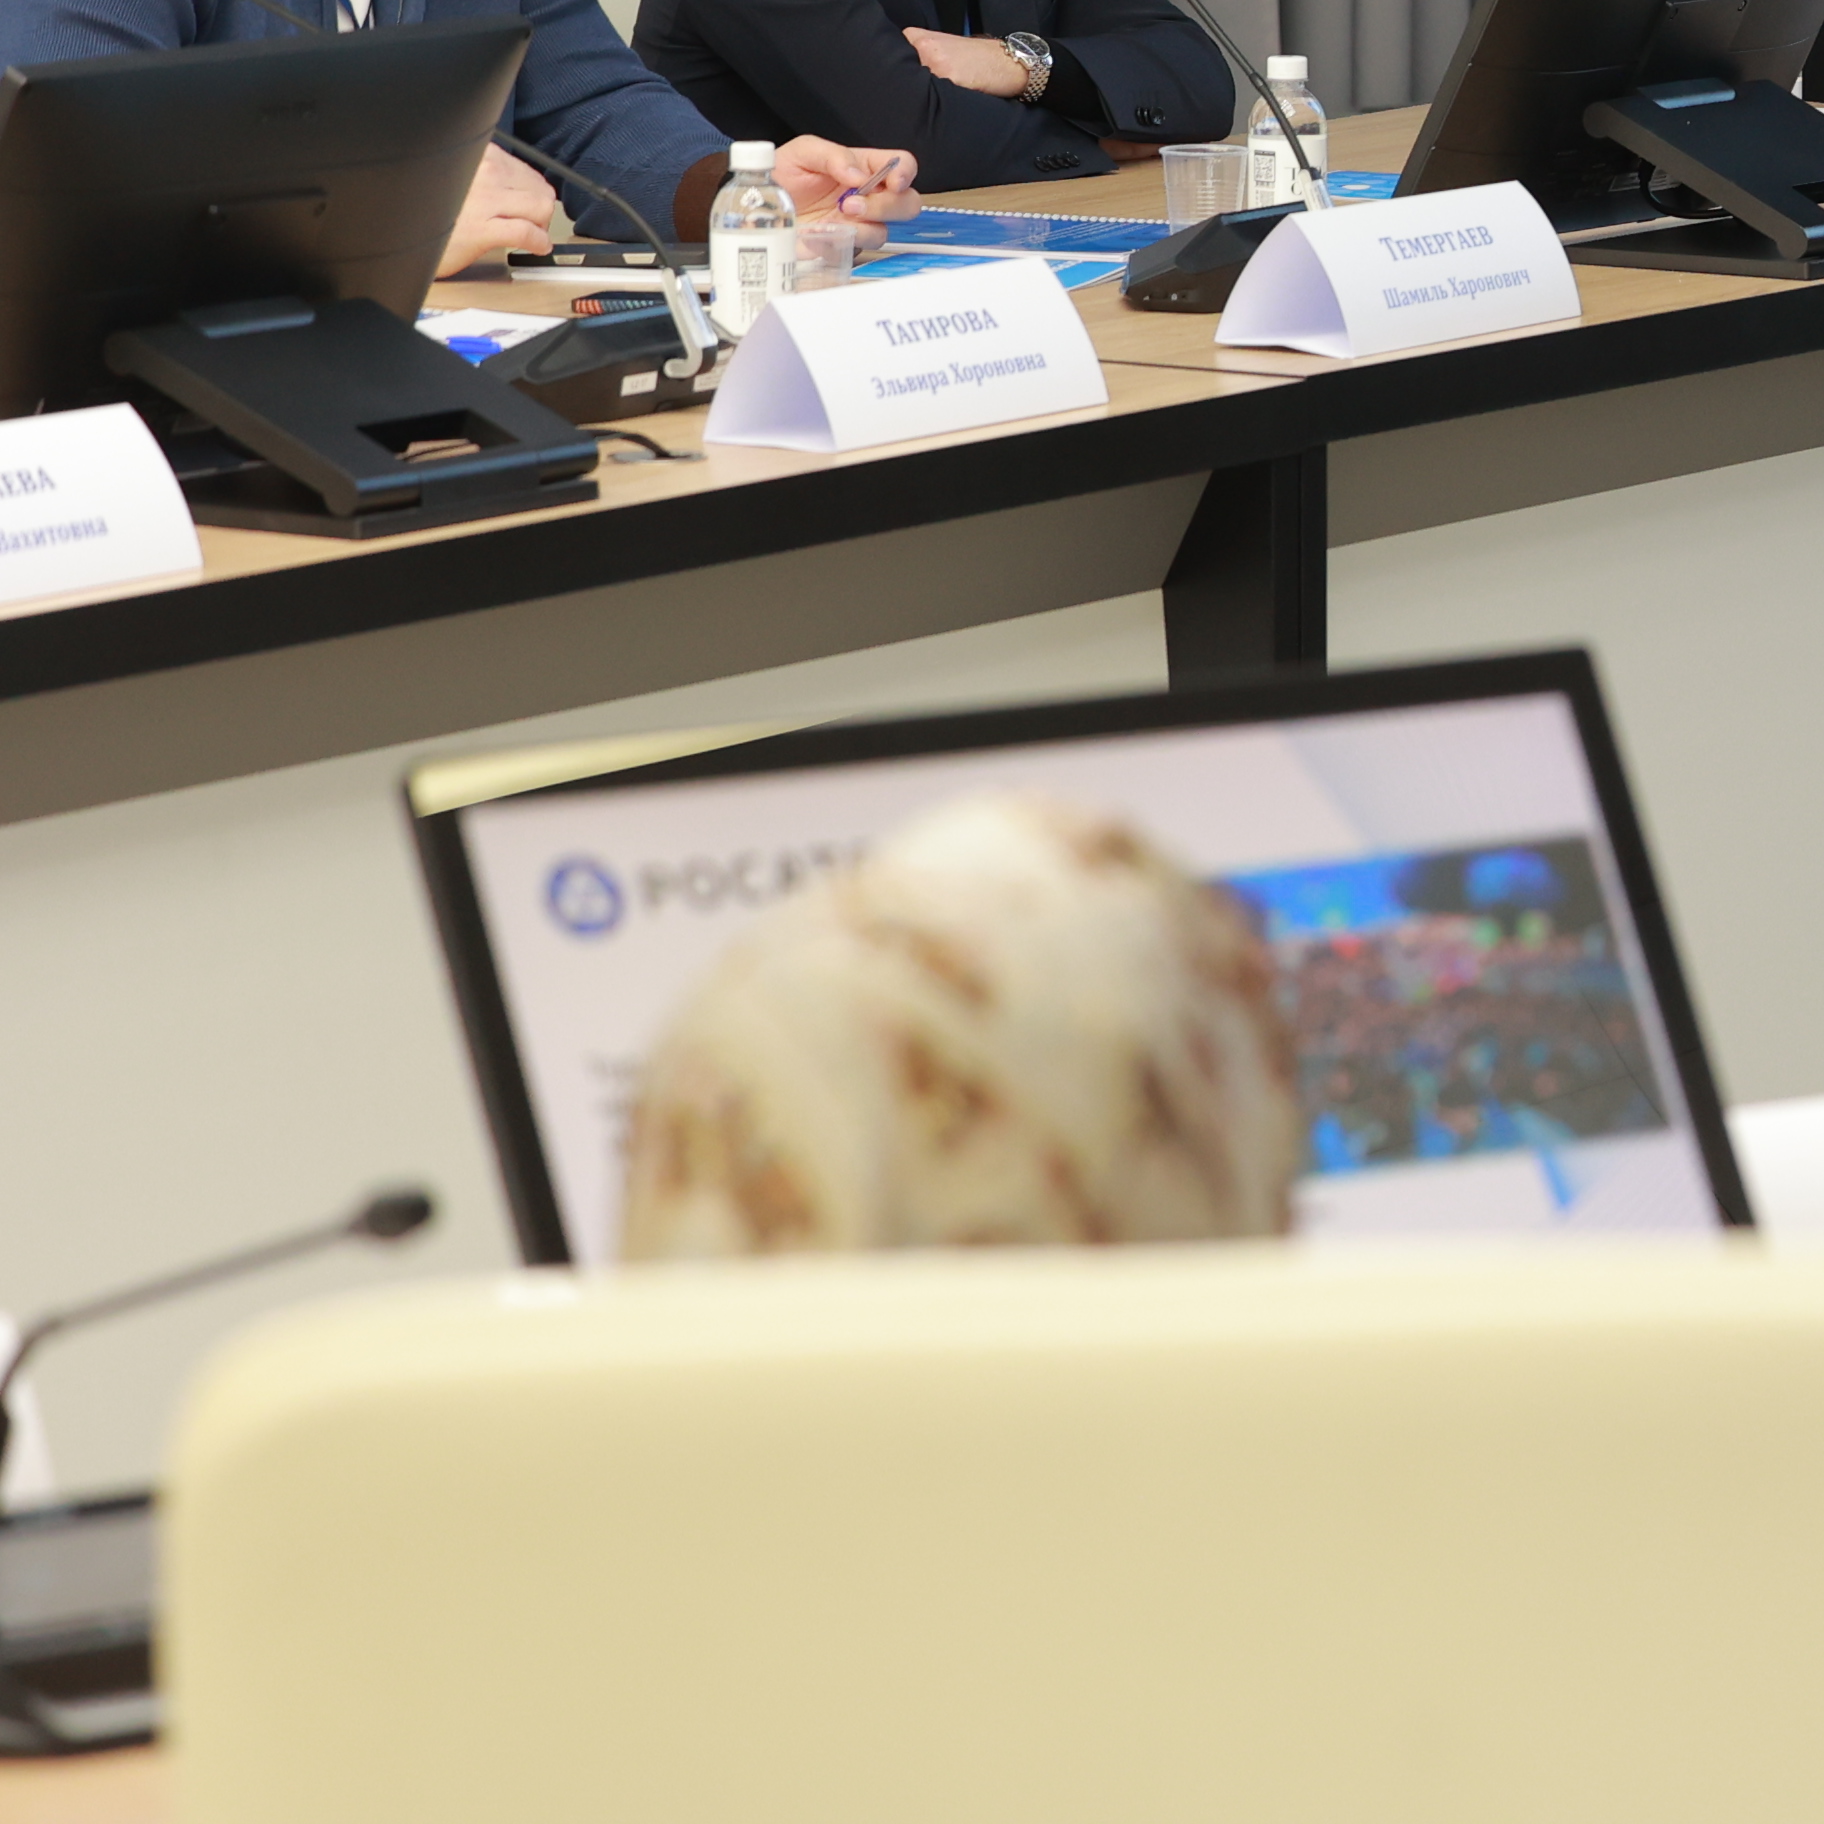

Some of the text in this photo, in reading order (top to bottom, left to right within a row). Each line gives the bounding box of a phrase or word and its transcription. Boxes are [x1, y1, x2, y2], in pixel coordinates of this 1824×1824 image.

[1379, 225, 1494, 262] ТЕМЕРГАЕВ
[1383, 269, 1532, 310] Шамиль Харонович
[876, 308, 999, 347] ТАГИРОВА
[871, 351, 1047, 399] Эльвира Хороновна
